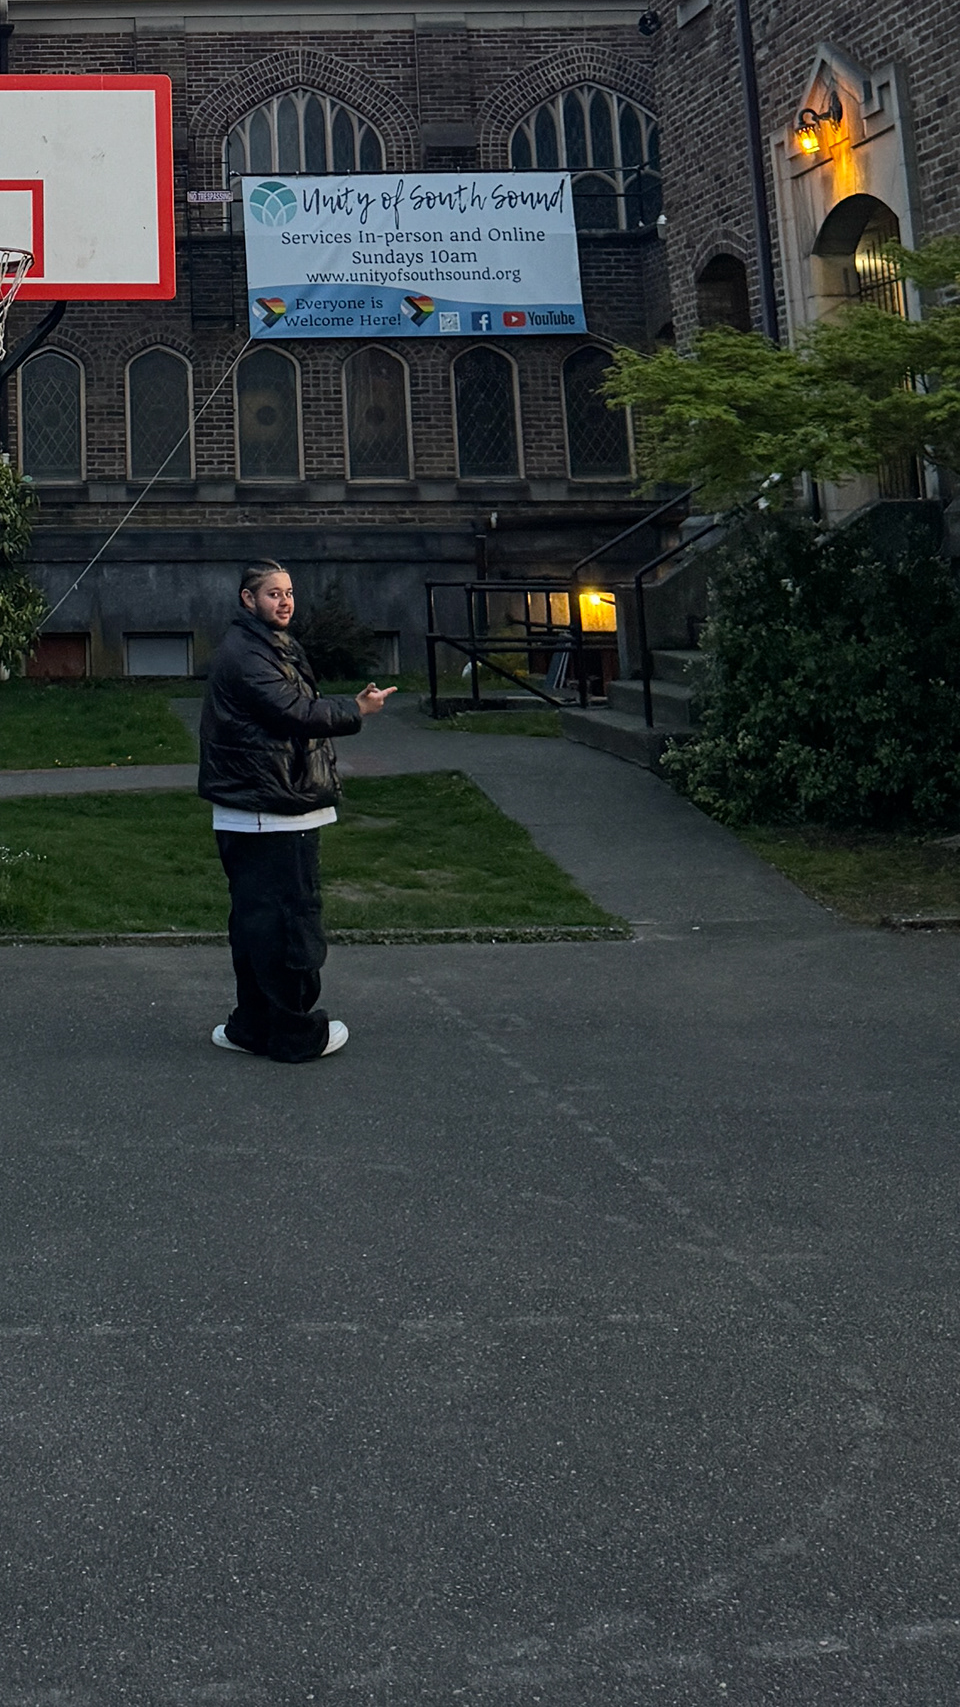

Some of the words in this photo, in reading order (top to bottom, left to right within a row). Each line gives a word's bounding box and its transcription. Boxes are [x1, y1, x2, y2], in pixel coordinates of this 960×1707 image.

[302, 187, 376, 225] Unity
[381, 179, 405, 230] of
[410, 181, 487, 214] South
[491, 178, 565, 214] Sound
[281, 230, 352, 245] Services
[358, 230, 443, 247] In-person
[449, 227, 482, 242] and
[487, 227, 546, 242] Online
[352, 249, 424, 268] Sundays
[430, 249, 478, 264] 10am
[306, 267, 522, 285] www.unityofsouthsound.org
[295, 297, 366, 312] Everyone
[371, 296, 384, 310] is
[283, 314, 354, 327] Welcome
[359, 313, 402, 326] Here!
[527, 310, 576, 326] YouTube
